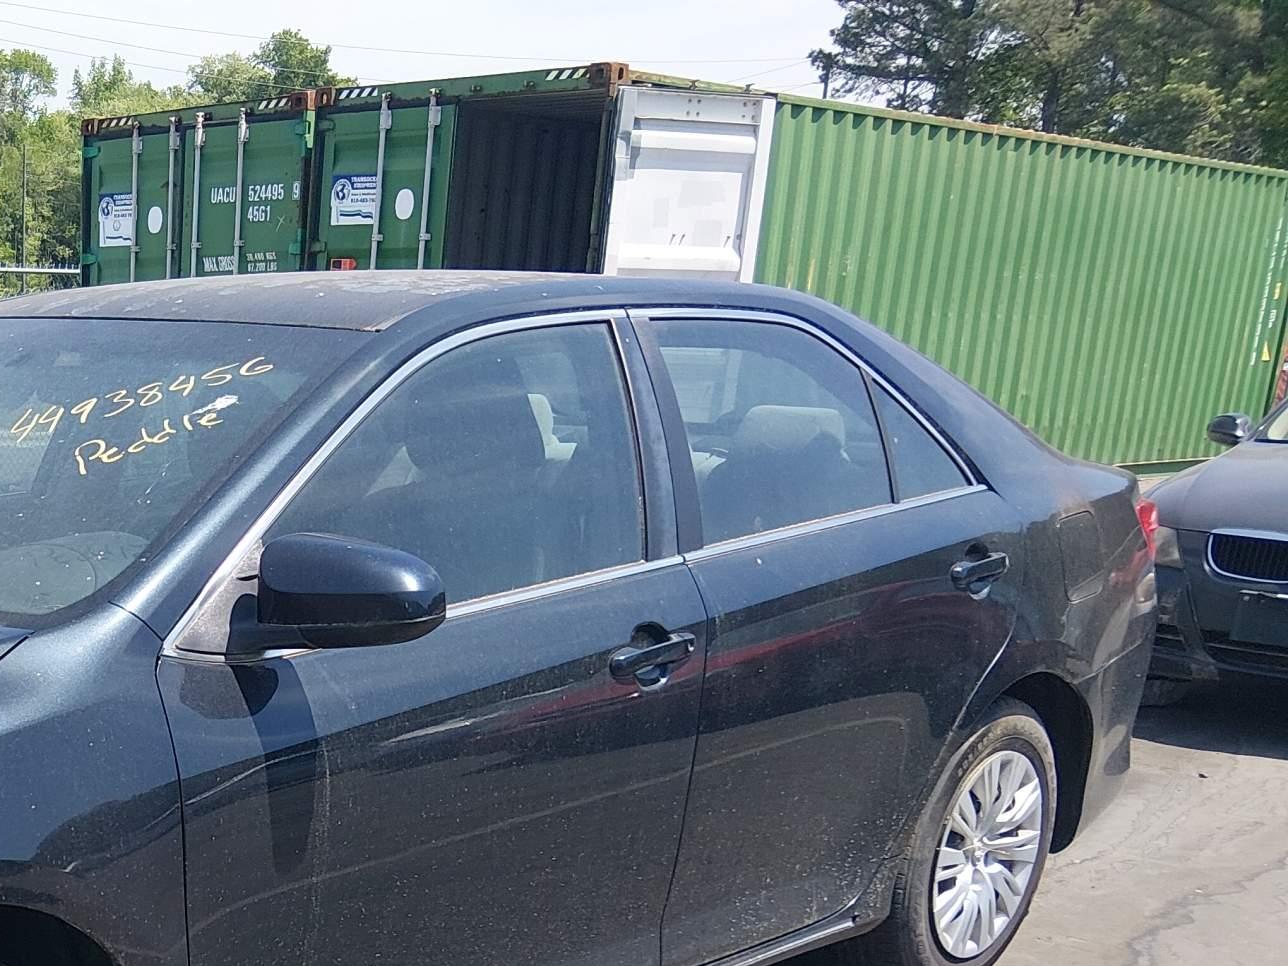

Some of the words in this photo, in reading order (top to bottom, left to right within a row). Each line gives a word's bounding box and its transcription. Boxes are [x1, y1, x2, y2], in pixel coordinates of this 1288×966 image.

[211, 186, 236, 204] UACU
[248, 183, 284, 202] 524495
[293, 182, 300, 199] 9
[247, 205, 271, 222] 45G1
[203, 256, 218, 272] MAX
[10, 356, 274, 448] 44938456
